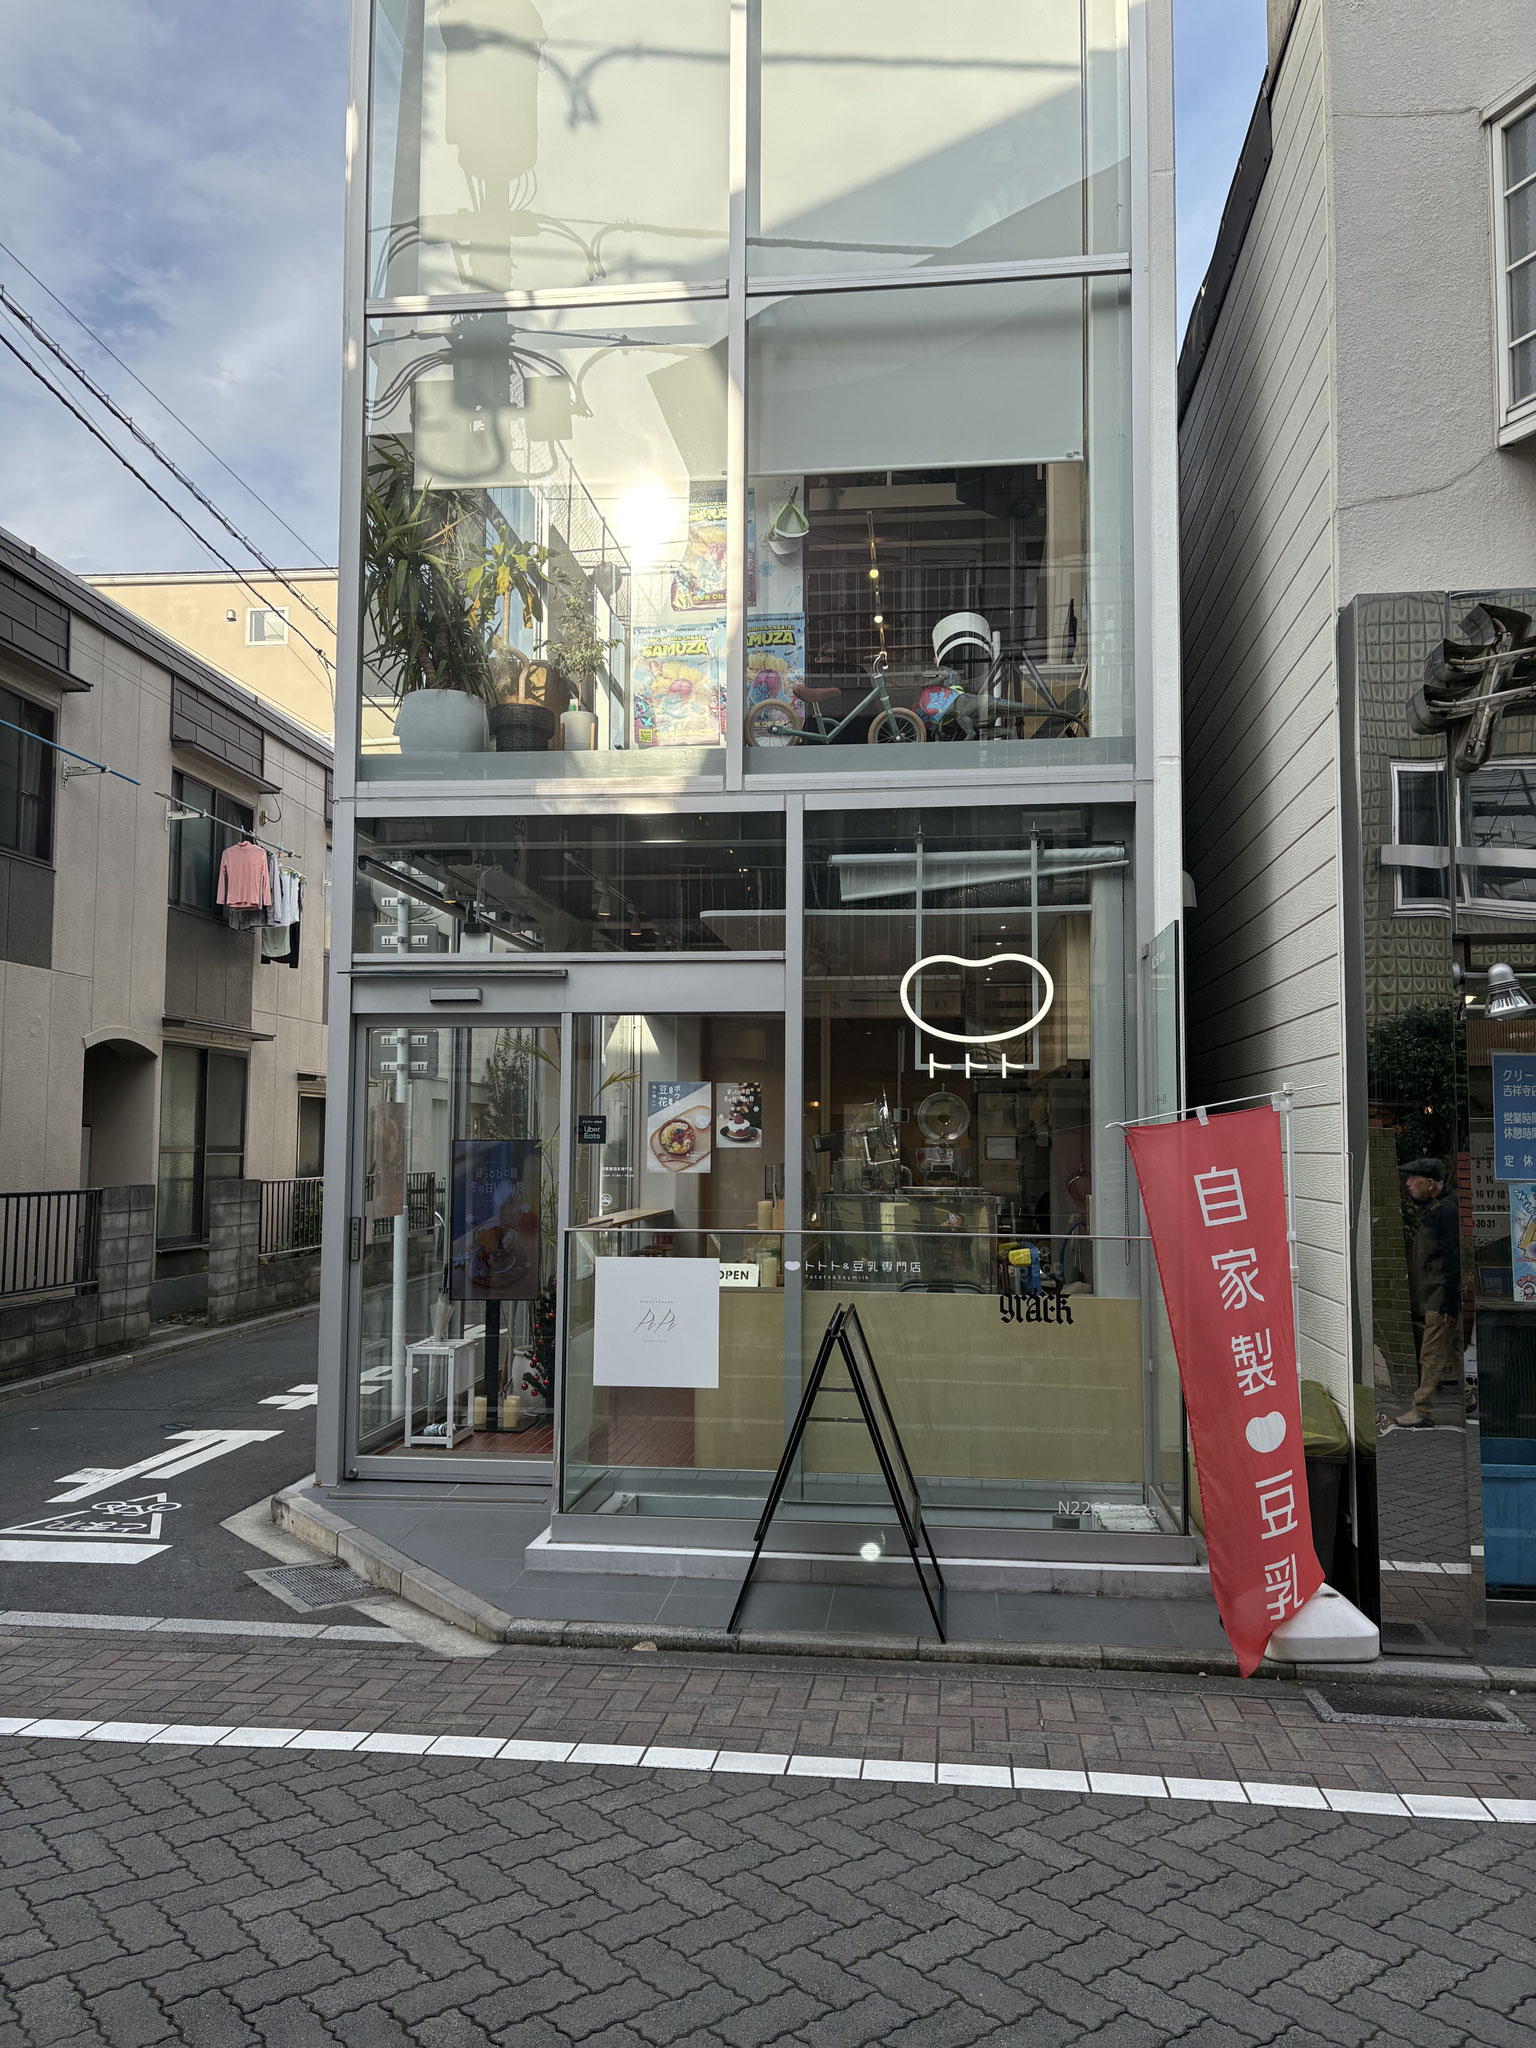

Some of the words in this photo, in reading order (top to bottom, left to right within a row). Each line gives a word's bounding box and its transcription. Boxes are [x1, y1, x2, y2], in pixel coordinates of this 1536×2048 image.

[642, 641, 709, 658] SAMUZA
[929, 1053, 1025, 1079] トトト
[658, 1085, 668, 1107] 豆花
[1475, 1160, 1481, 1168] 2
[1476, 1175, 1482, 1184] 9
[1476, 1190, 1484, 1198] 16
[1486, 1190, 1494, 1198] 17
[1497, 1190, 1505, 1198] 18
[1476, 1219, 1485, 1228] 30
[1487, 1219, 1495, 1228] 31
[805, 1260, 921, 1273] トトト&豆乳専門店
